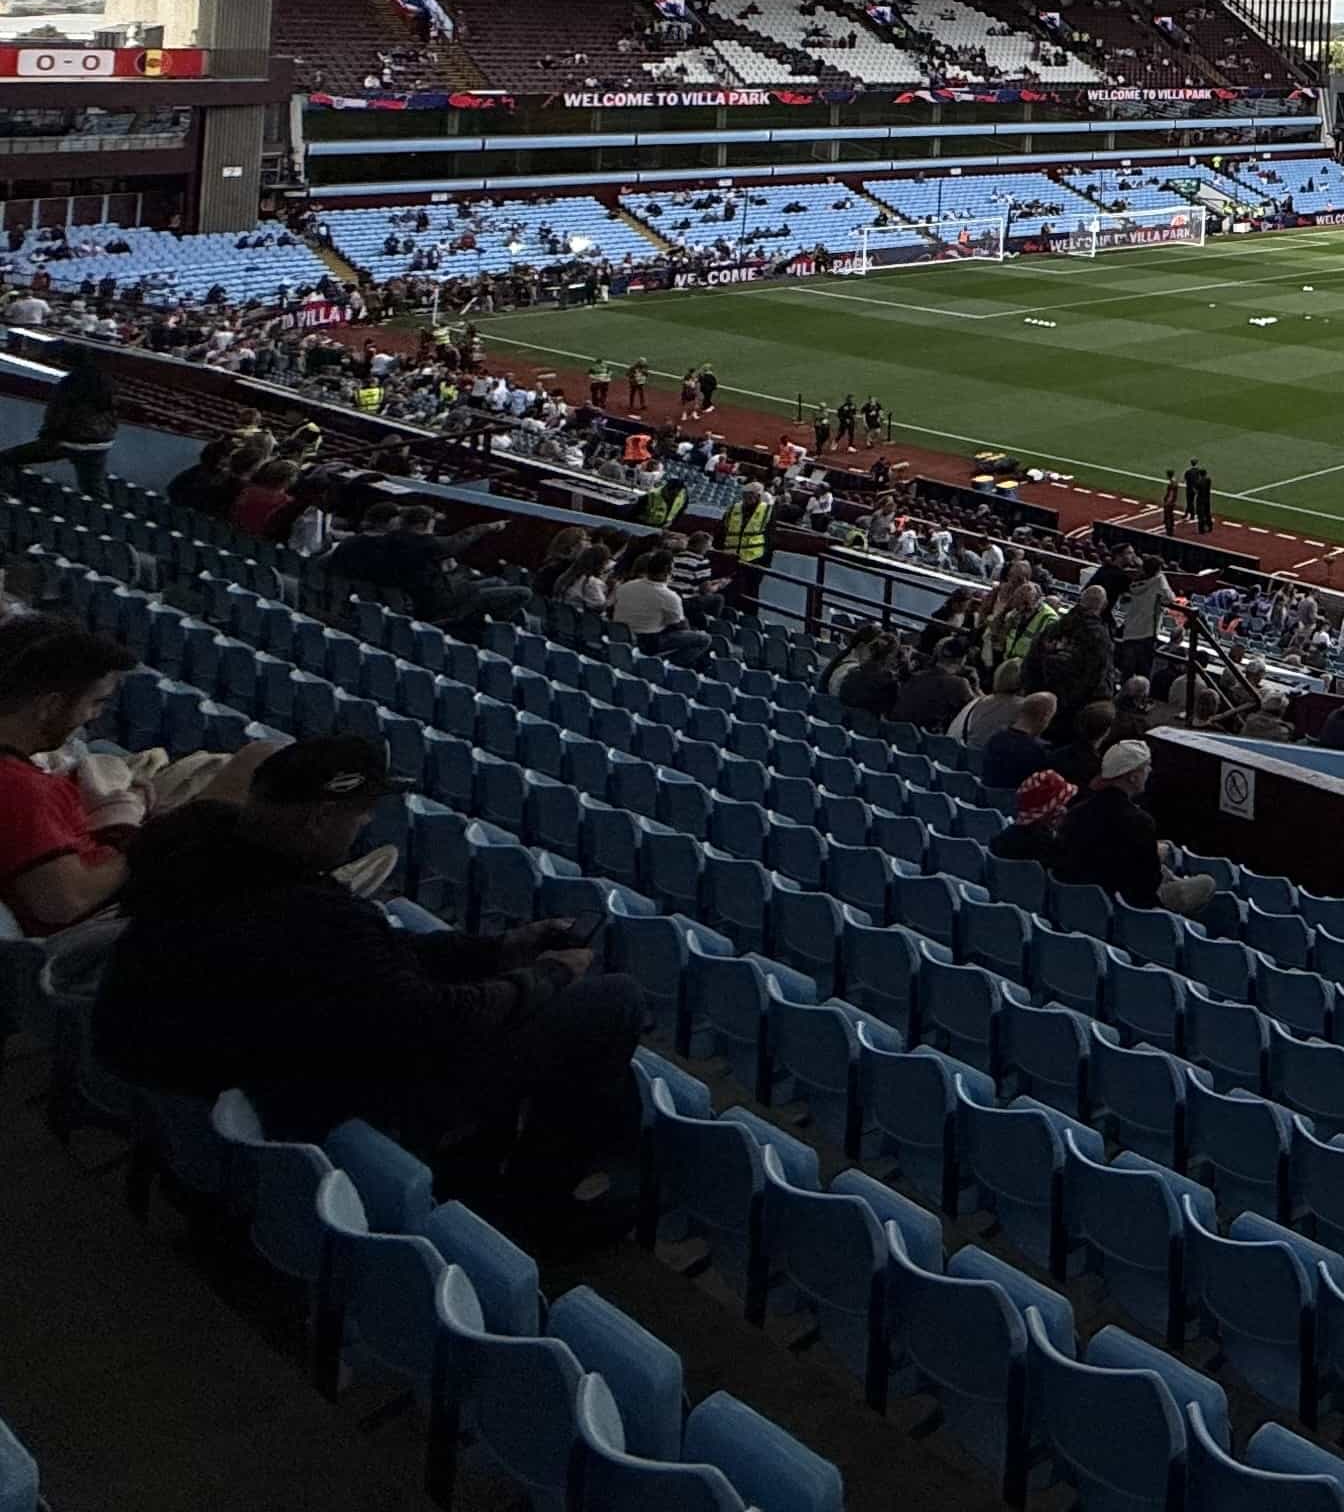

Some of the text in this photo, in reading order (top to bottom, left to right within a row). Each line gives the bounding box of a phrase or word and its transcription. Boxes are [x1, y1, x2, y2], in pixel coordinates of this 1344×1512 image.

[563, 91, 770, 107] WELCOME TO VILLA PARK
[1087, 88, 1212, 101] WELCOME TO VILLA PARK
[1129, 230, 1161, 243] VILLA
[1162, 226, 1190, 241] PARK
[786, 261, 826, 276] VILL
